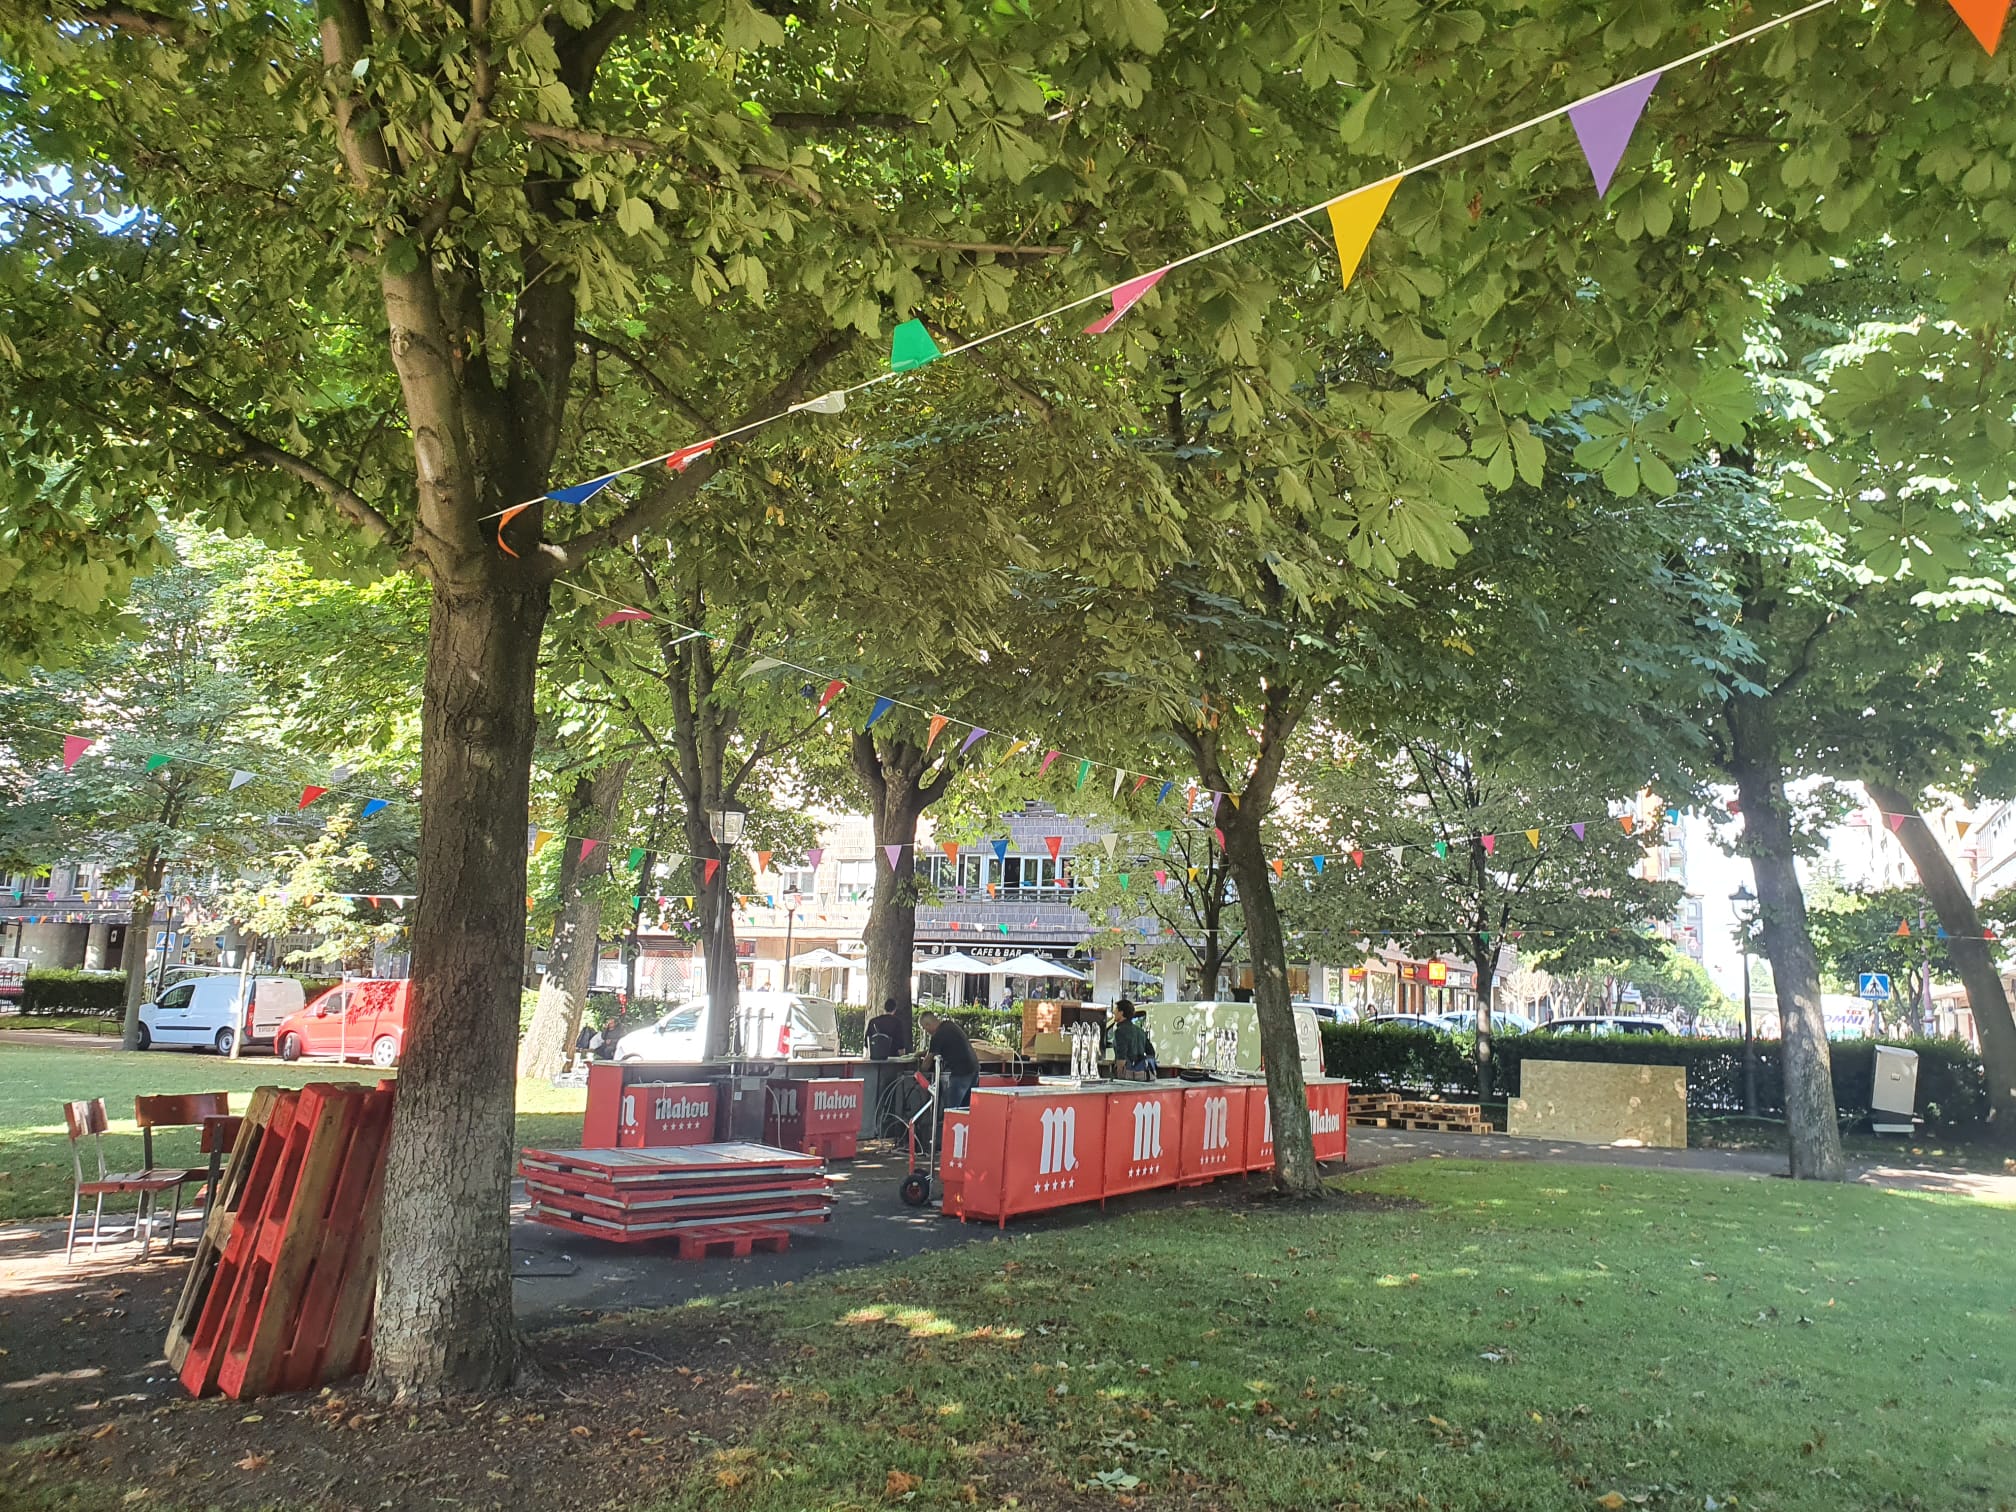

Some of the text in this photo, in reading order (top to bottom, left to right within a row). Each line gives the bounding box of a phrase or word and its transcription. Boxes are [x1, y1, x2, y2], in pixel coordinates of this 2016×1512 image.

[970, 947, 1022, 957] CAFE & BAR
[655, 1096, 709, 1120] Mahou
[814, 1089, 857, 1111] Mahou
